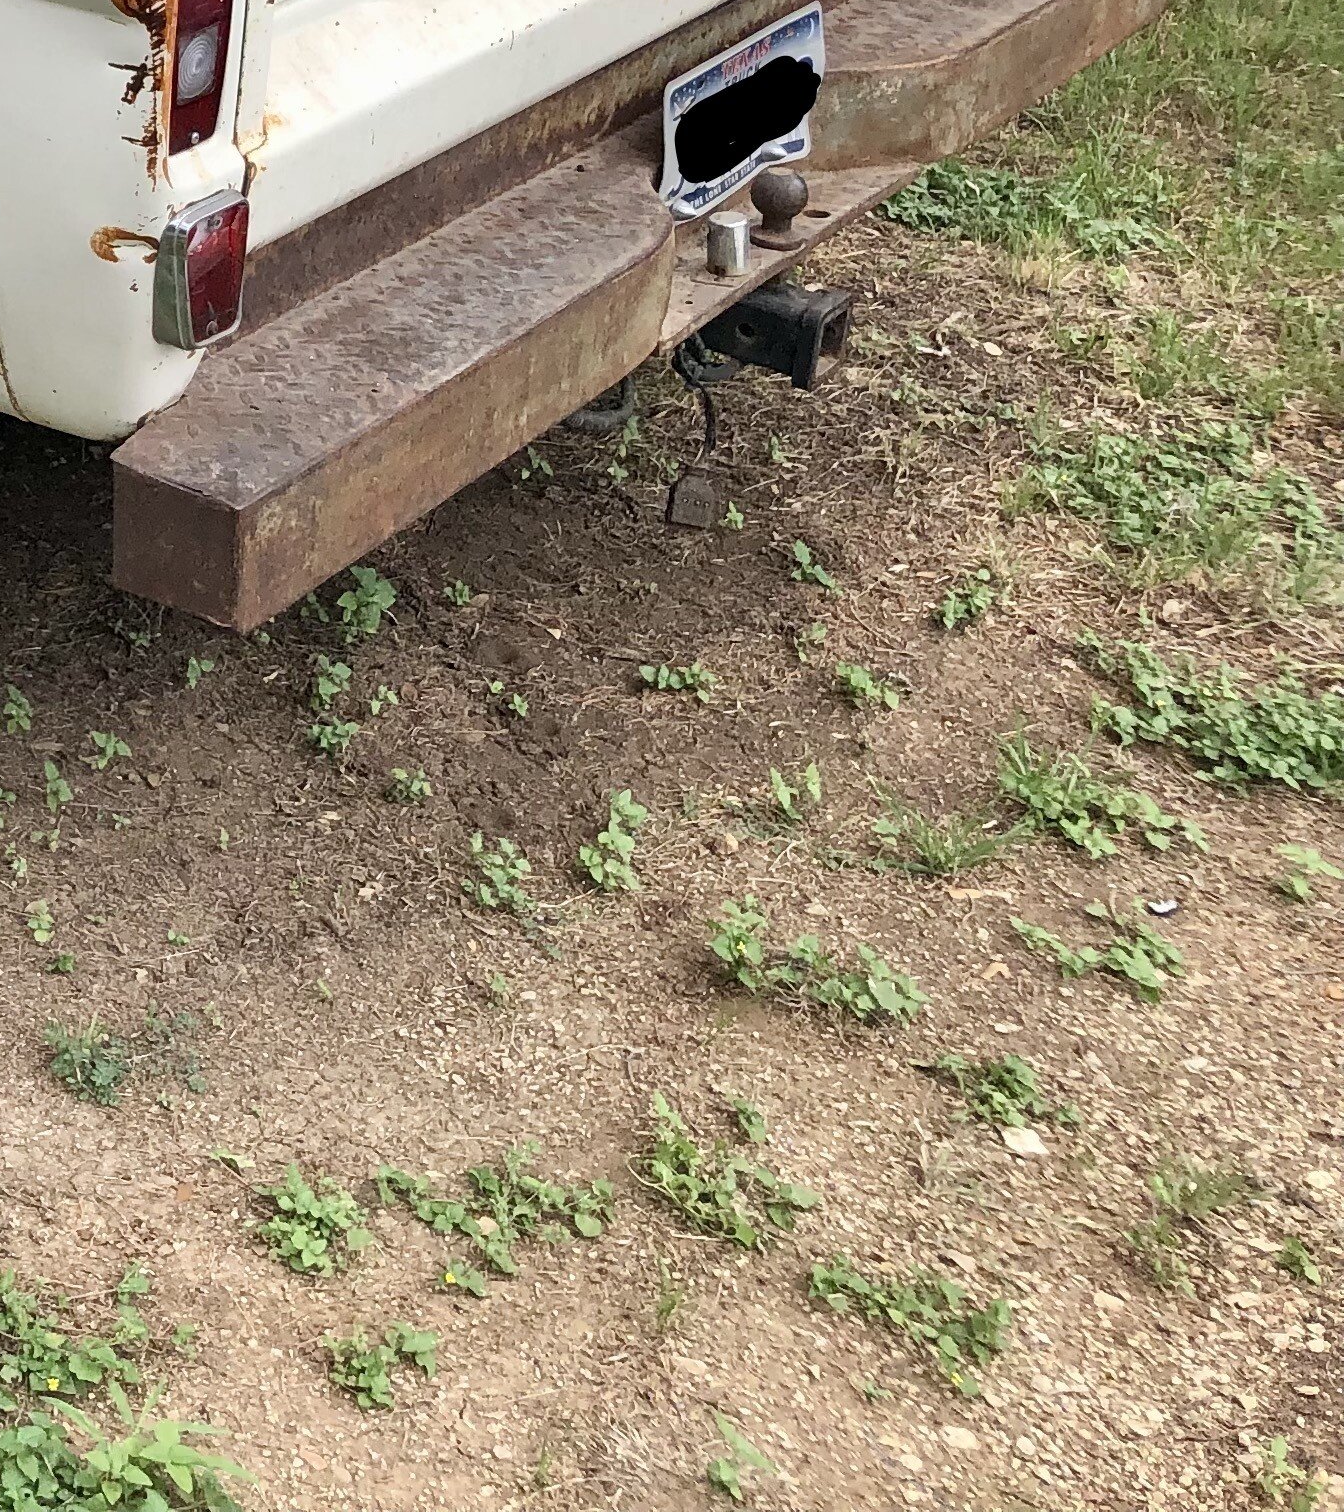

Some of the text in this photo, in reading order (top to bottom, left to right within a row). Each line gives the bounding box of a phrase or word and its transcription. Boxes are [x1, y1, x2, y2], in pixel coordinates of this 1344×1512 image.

[721, 35, 772, 80] TEXAS
[704, 184, 723, 203] LONE
[723, 170, 739, 190] STAR
[739, 159, 757, 177] STATE
